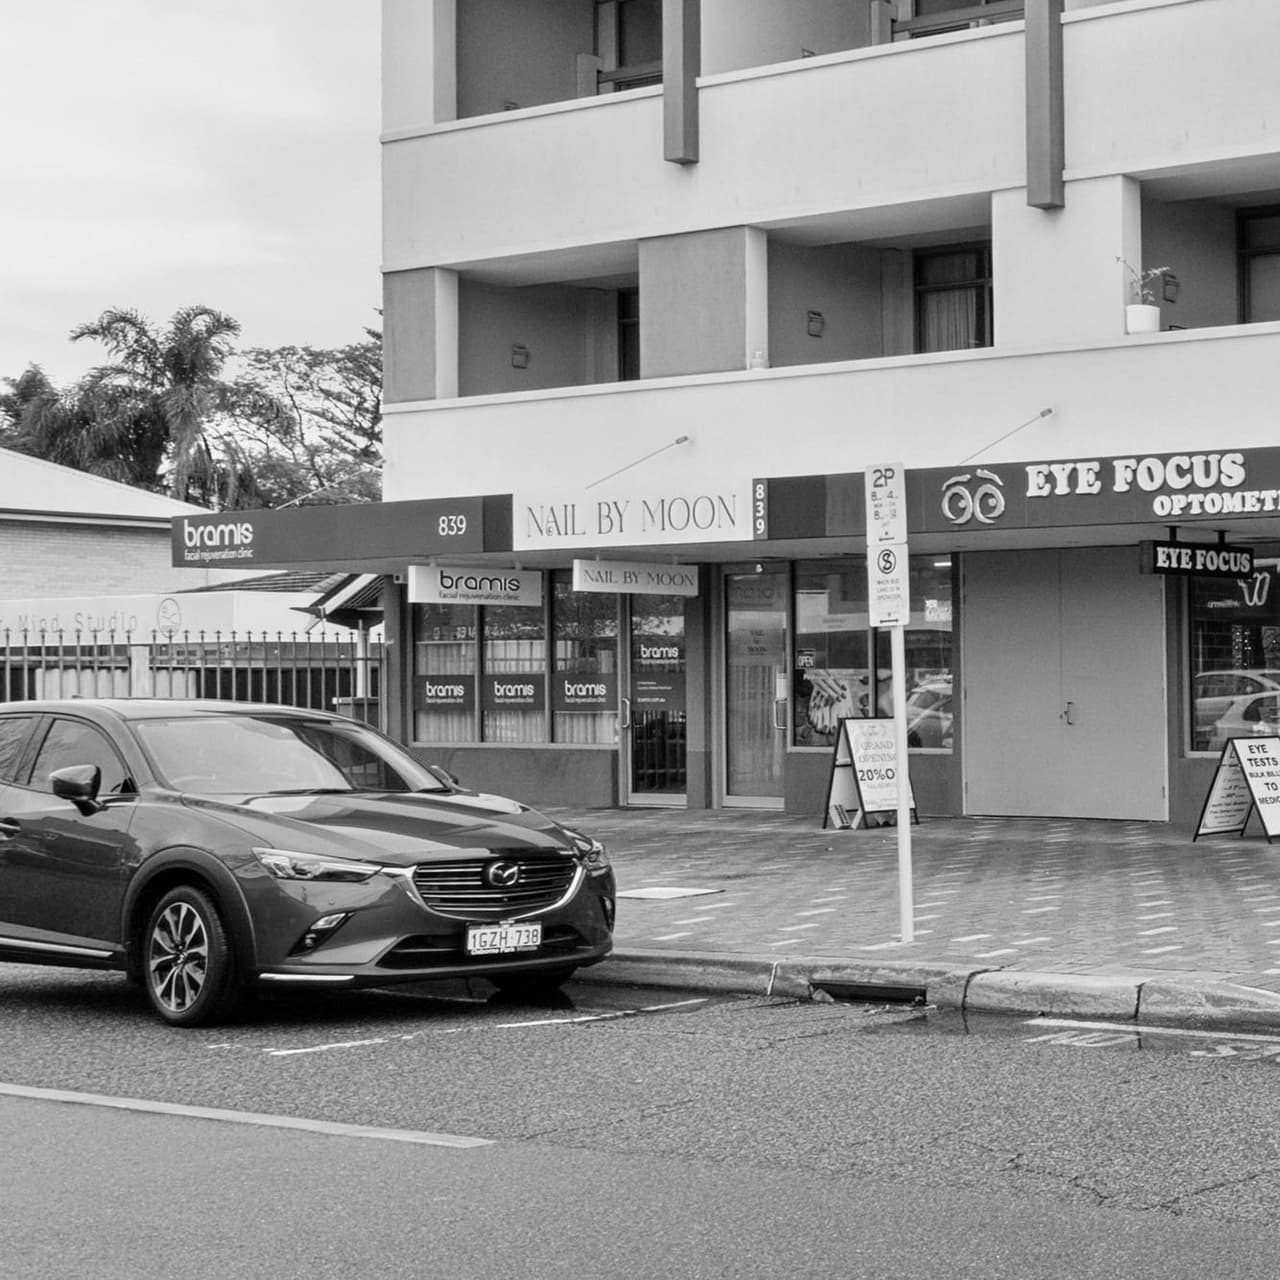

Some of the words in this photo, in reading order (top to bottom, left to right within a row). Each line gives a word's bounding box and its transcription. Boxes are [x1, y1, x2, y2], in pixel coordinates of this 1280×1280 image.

[873, 468, 895, 488] 2P
[1025, 461, 1102, 498] EYE
[1112, 452, 1246, 493] FOCUS
[527, 503, 586, 538] NAIL
[596, 500, 630, 535] BY
[642, 494, 737, 533] MOON
[755, 484, 765, 534] 839
[184, 519, 254, 547] bramis
[438, 515, 467, 535] 839
[1156, 547, 1193, 569] EYE
[1195, 549, 1251, 572] FOCUS
[440, 570, 520, 592] bramis
[584, 569, 618, 584] NAIL
[623, 571, 641, 585] BY
[647, 572, 695, 587] MOON
[641, 643, 679, 658] bramis
[426, 681, 465, 696] bramis
[494, 681, 534, 696] bramis
[564, 680, 606, 696] bramis
[1248, 744, 1268, 754] EYE
[1247, 757, 1279, 767] TESTS
[858, 768, 897, 782] 20%O
[1264, 782, 1278, 791] TO
